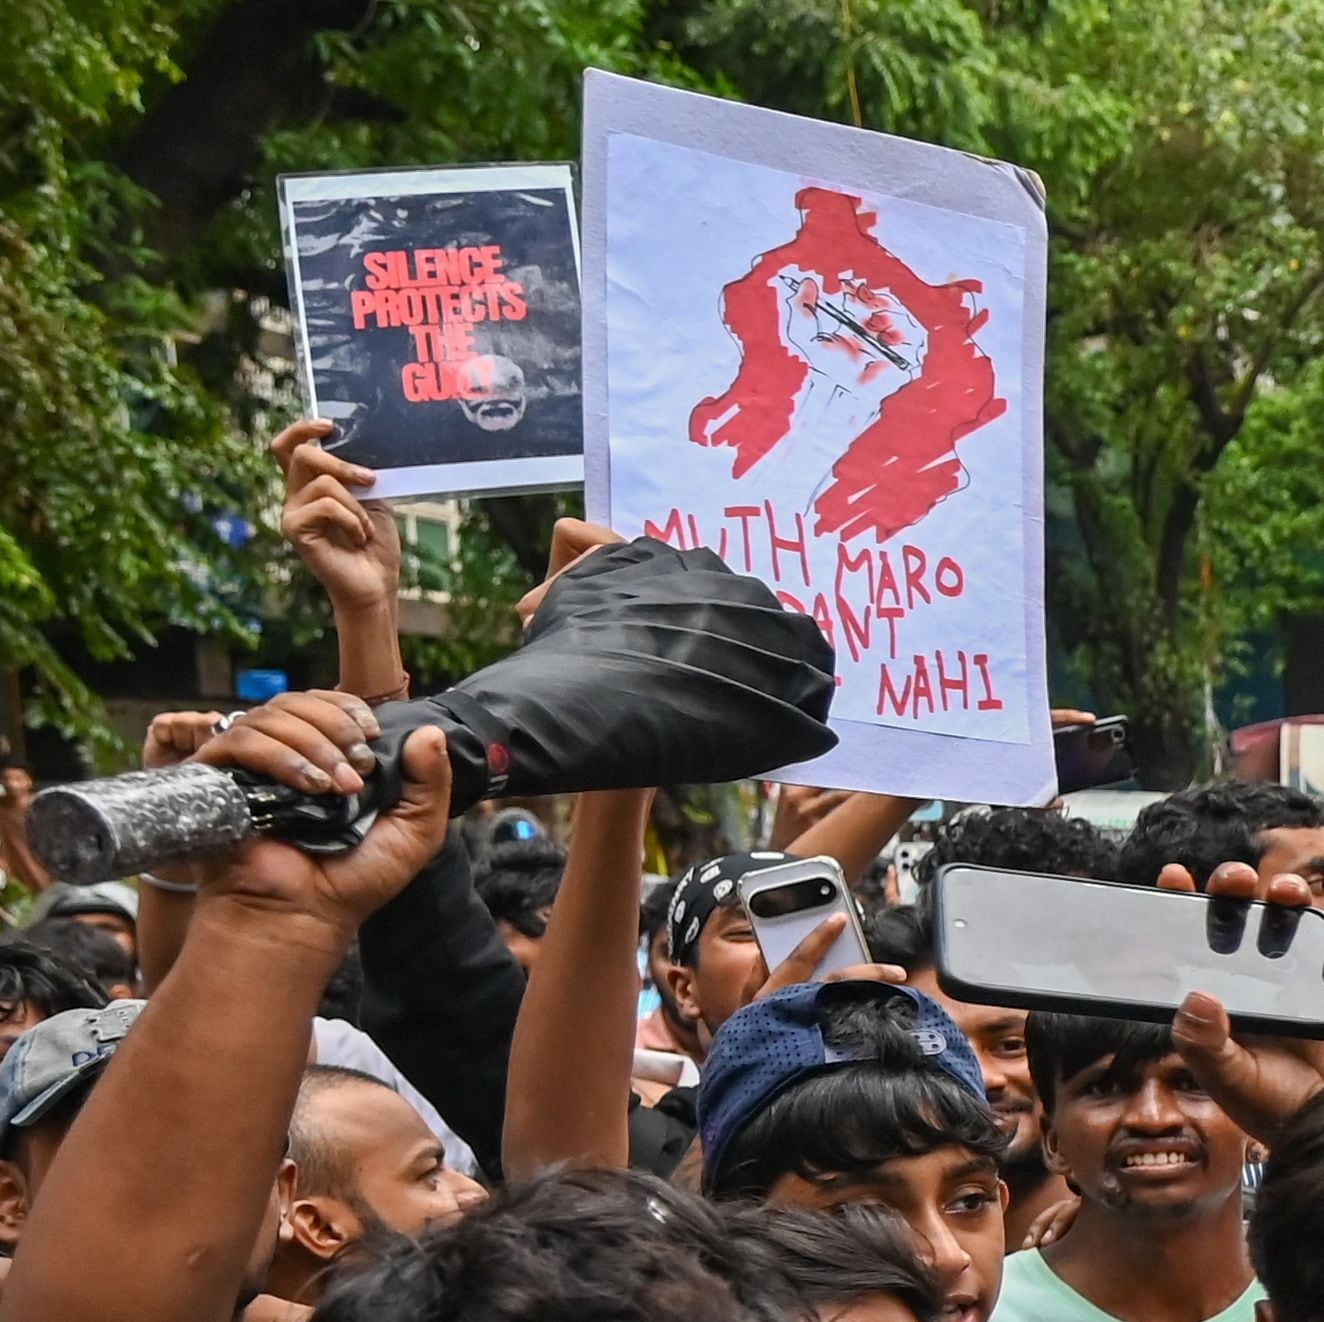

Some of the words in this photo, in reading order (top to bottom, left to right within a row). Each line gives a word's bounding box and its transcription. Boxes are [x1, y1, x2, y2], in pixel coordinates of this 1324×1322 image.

[363, 245, 506, 290] SILENCE
[351, 282, 527, 330] PROTECTS
[409, 322, 478, 363] THE
[835, 542, 964, 611] MARO
[776, 589, 904, 663] ANT
[877, 650, 1004, 719] NAHI
